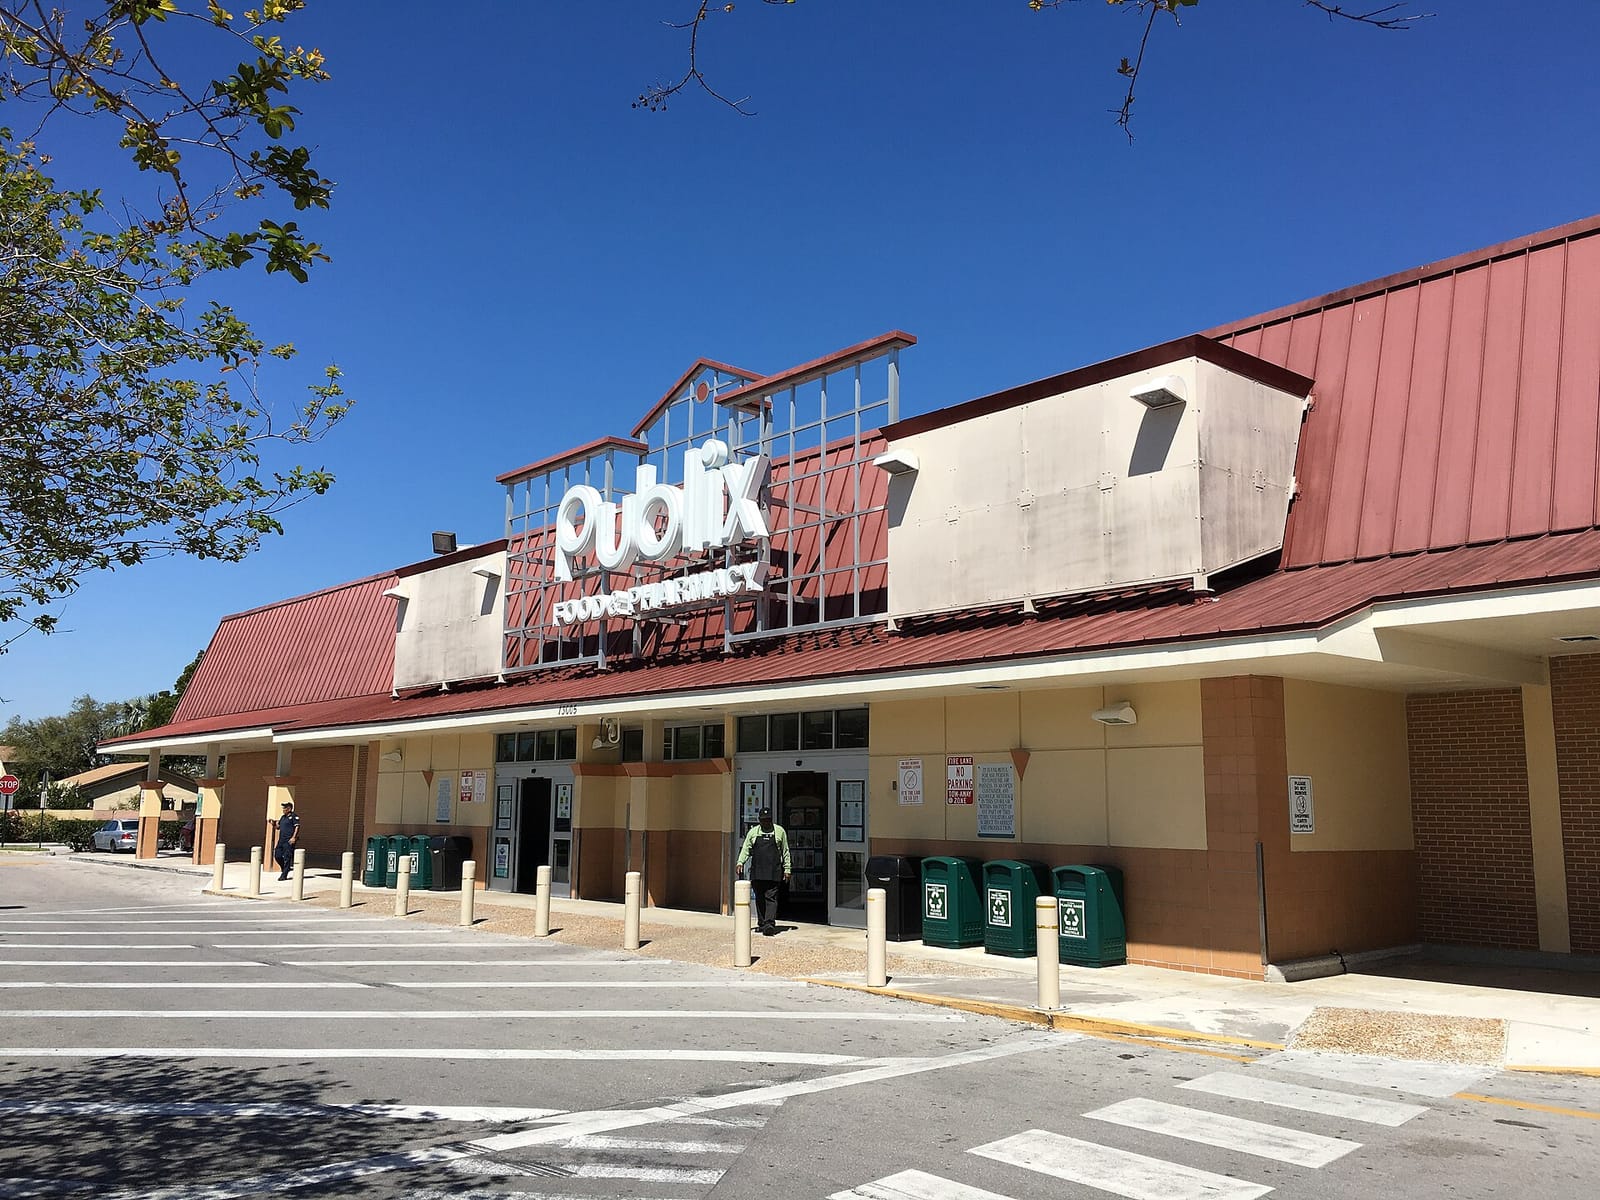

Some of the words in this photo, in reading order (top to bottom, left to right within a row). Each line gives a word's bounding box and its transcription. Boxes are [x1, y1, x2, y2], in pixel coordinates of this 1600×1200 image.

[554, 439, 770, 582] Publix
[553, 594, 611, 627] FOOD
[609, 590, 633, 617] &
[628, 561, 768, 614] PHARMACY
[955, 766, 965, 777] NO
[0, 780, 18, 789] STOP
[947, 779, 973, 789] PARKING
